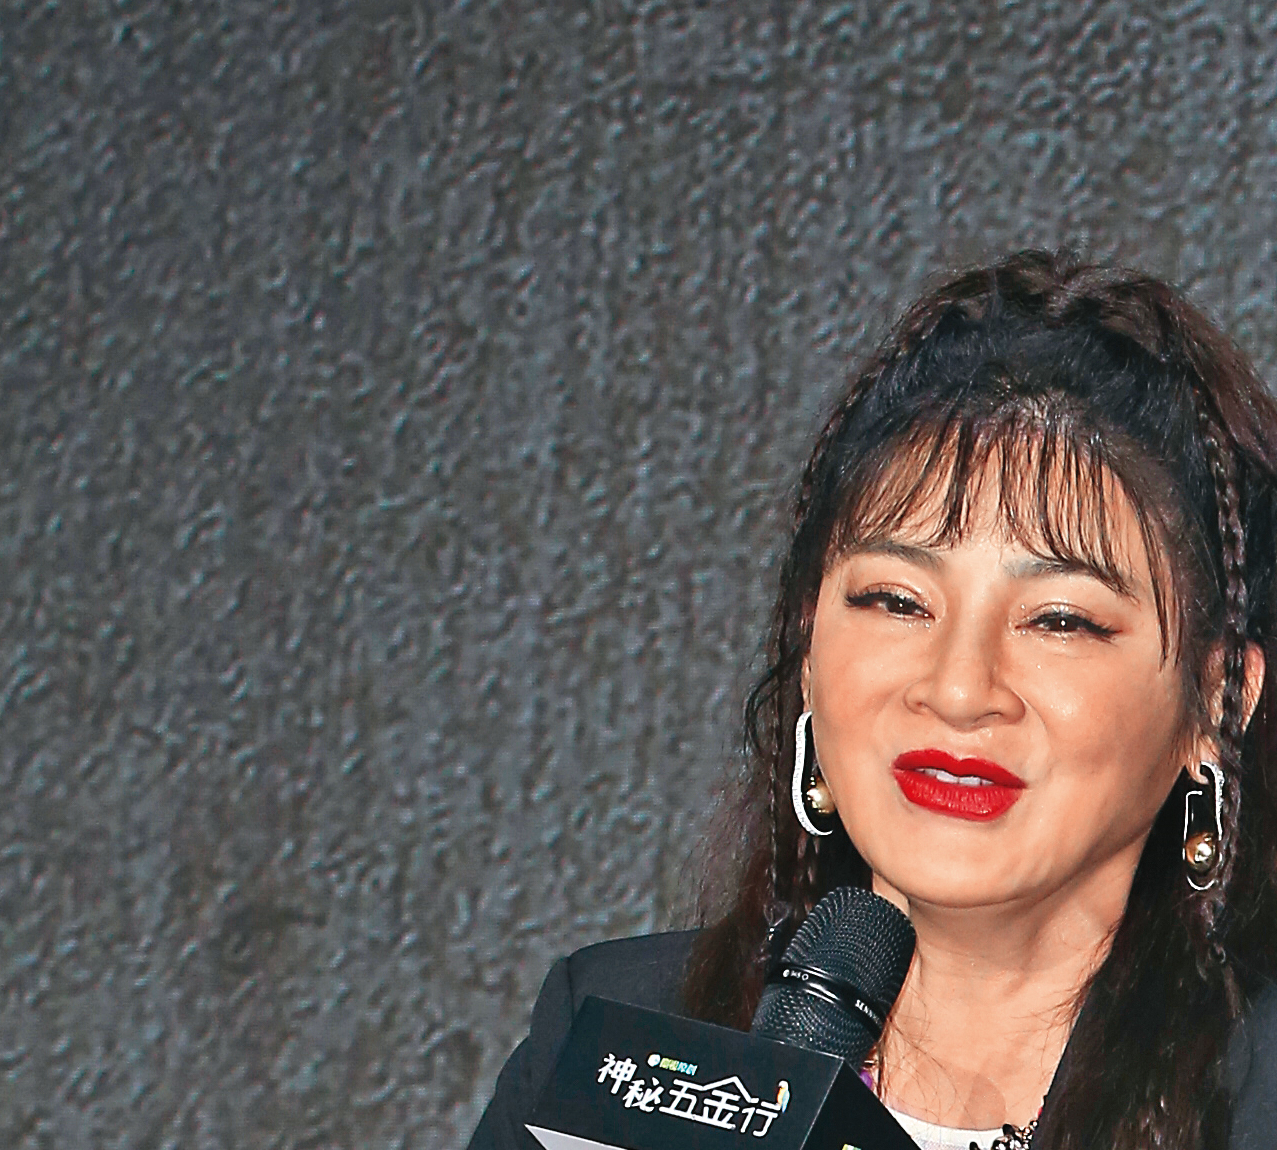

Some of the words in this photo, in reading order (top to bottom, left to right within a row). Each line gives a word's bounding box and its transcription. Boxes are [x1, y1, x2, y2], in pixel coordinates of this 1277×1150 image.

[597, 1053, 781, 1137] 神秘五金行
